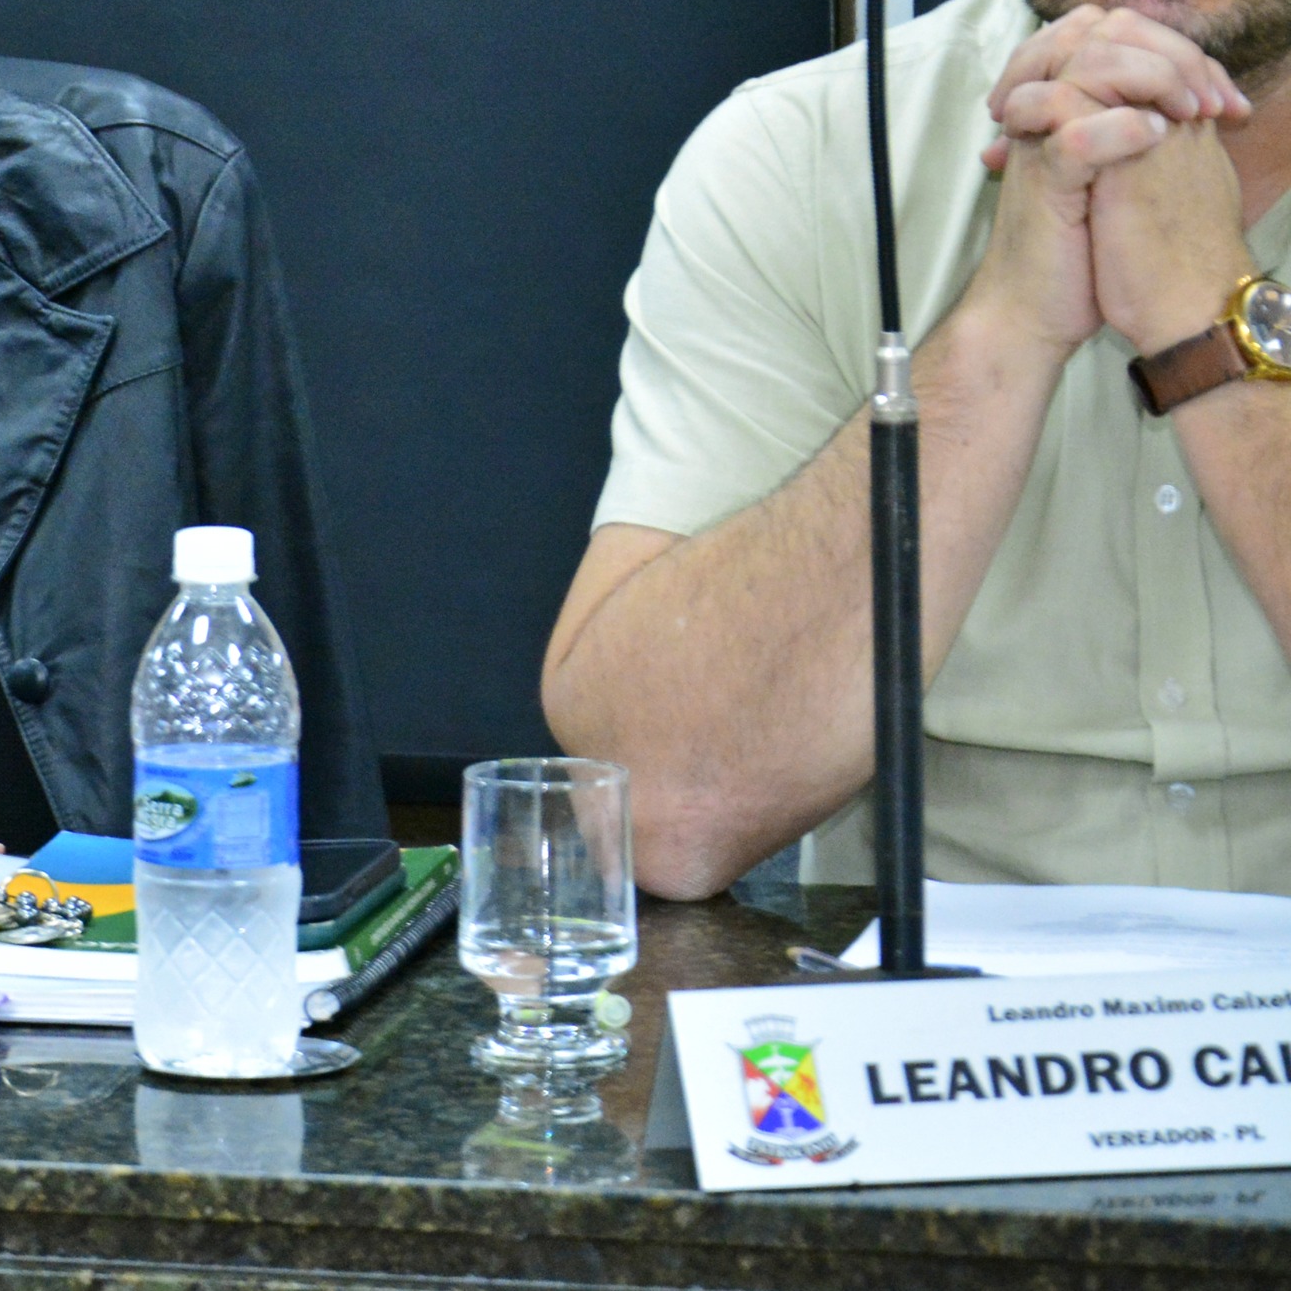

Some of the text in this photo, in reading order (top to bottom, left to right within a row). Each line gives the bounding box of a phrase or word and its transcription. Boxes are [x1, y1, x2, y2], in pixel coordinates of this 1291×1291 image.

[987, 1001, 1095, 1022] Leandro
[1101, 996, 1205, 1016] Maximo
[865, 1047, 1173, 1105] LEANDRO
[1089, 1125, 1217, 1148] VEREADOR
[1235, 1124, 1266, 1140] PL
